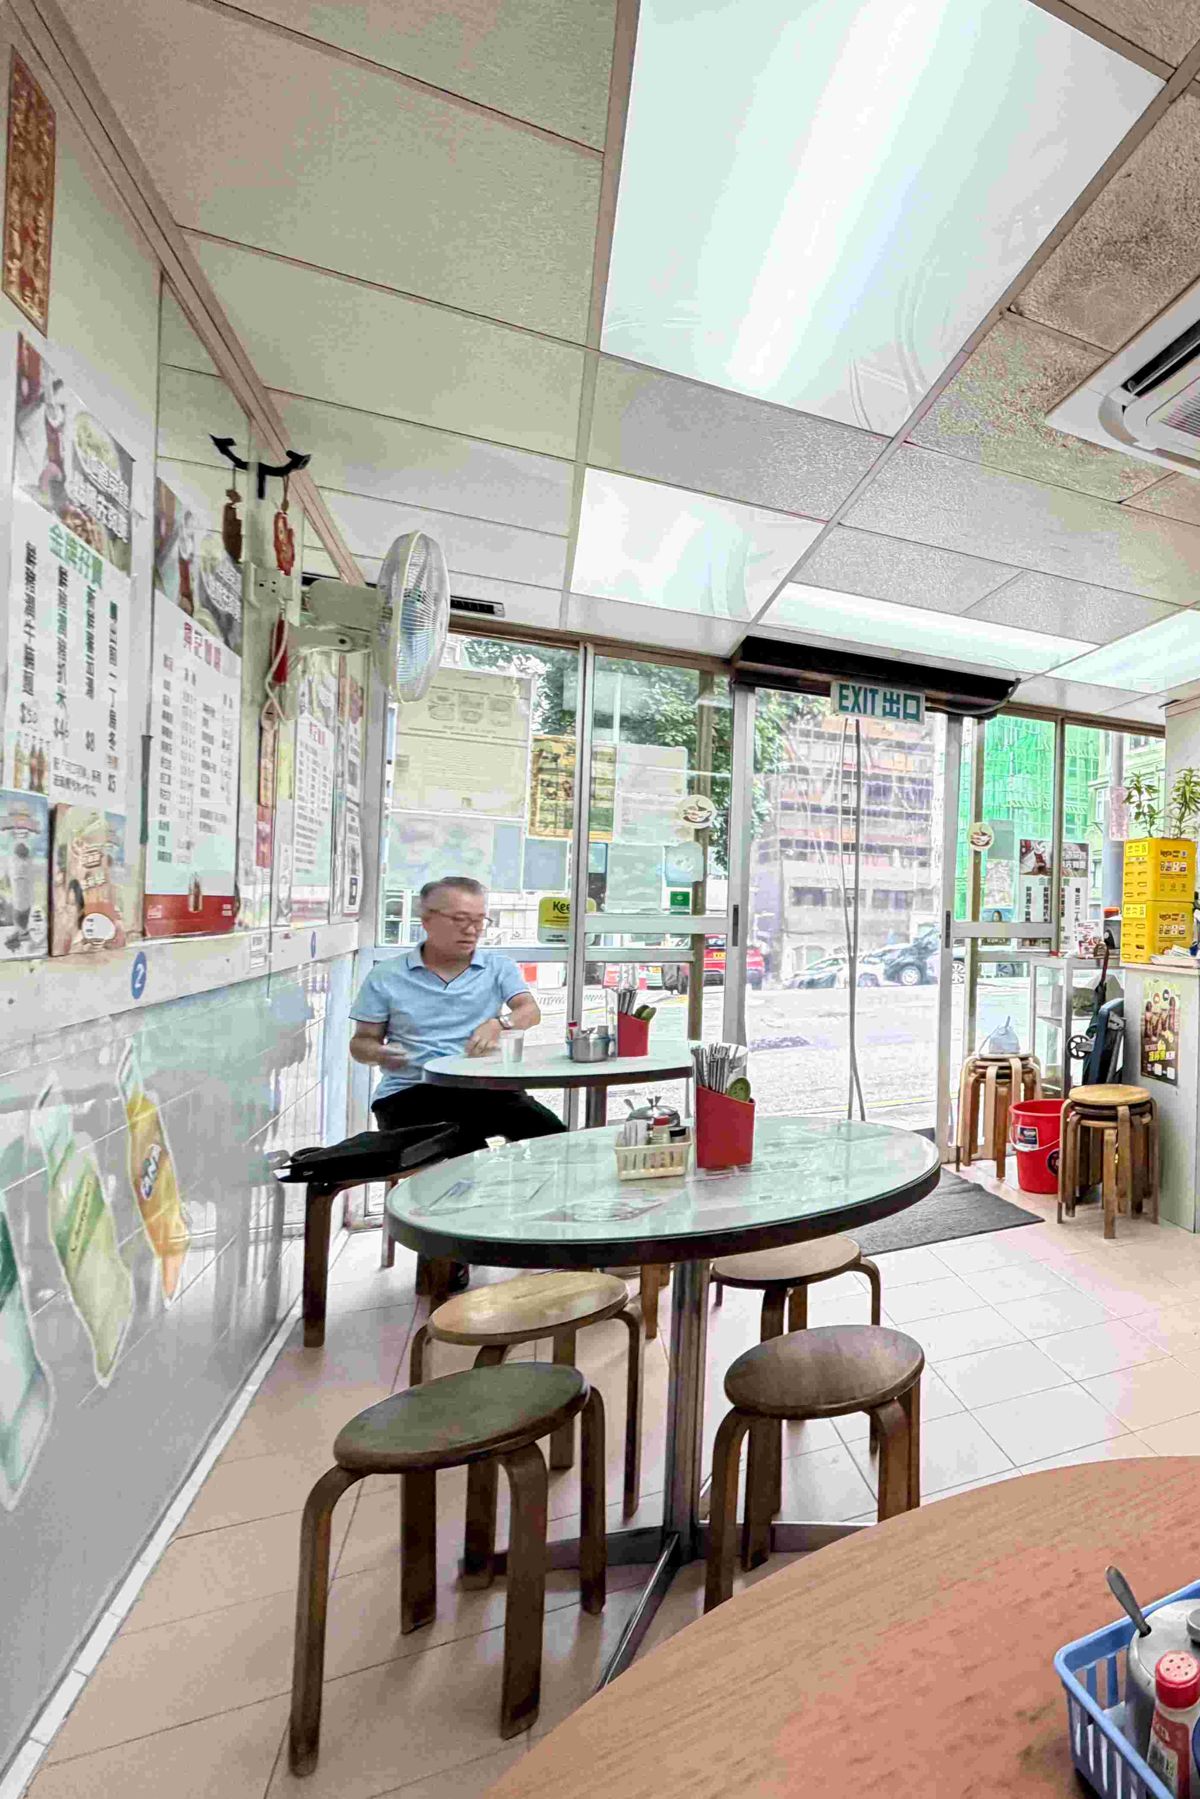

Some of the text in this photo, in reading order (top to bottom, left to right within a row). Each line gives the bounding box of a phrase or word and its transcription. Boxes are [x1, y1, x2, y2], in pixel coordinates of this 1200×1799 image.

[839, 684, 920, 722] EXIT 出口
[135, 963, 145, 989] 2
